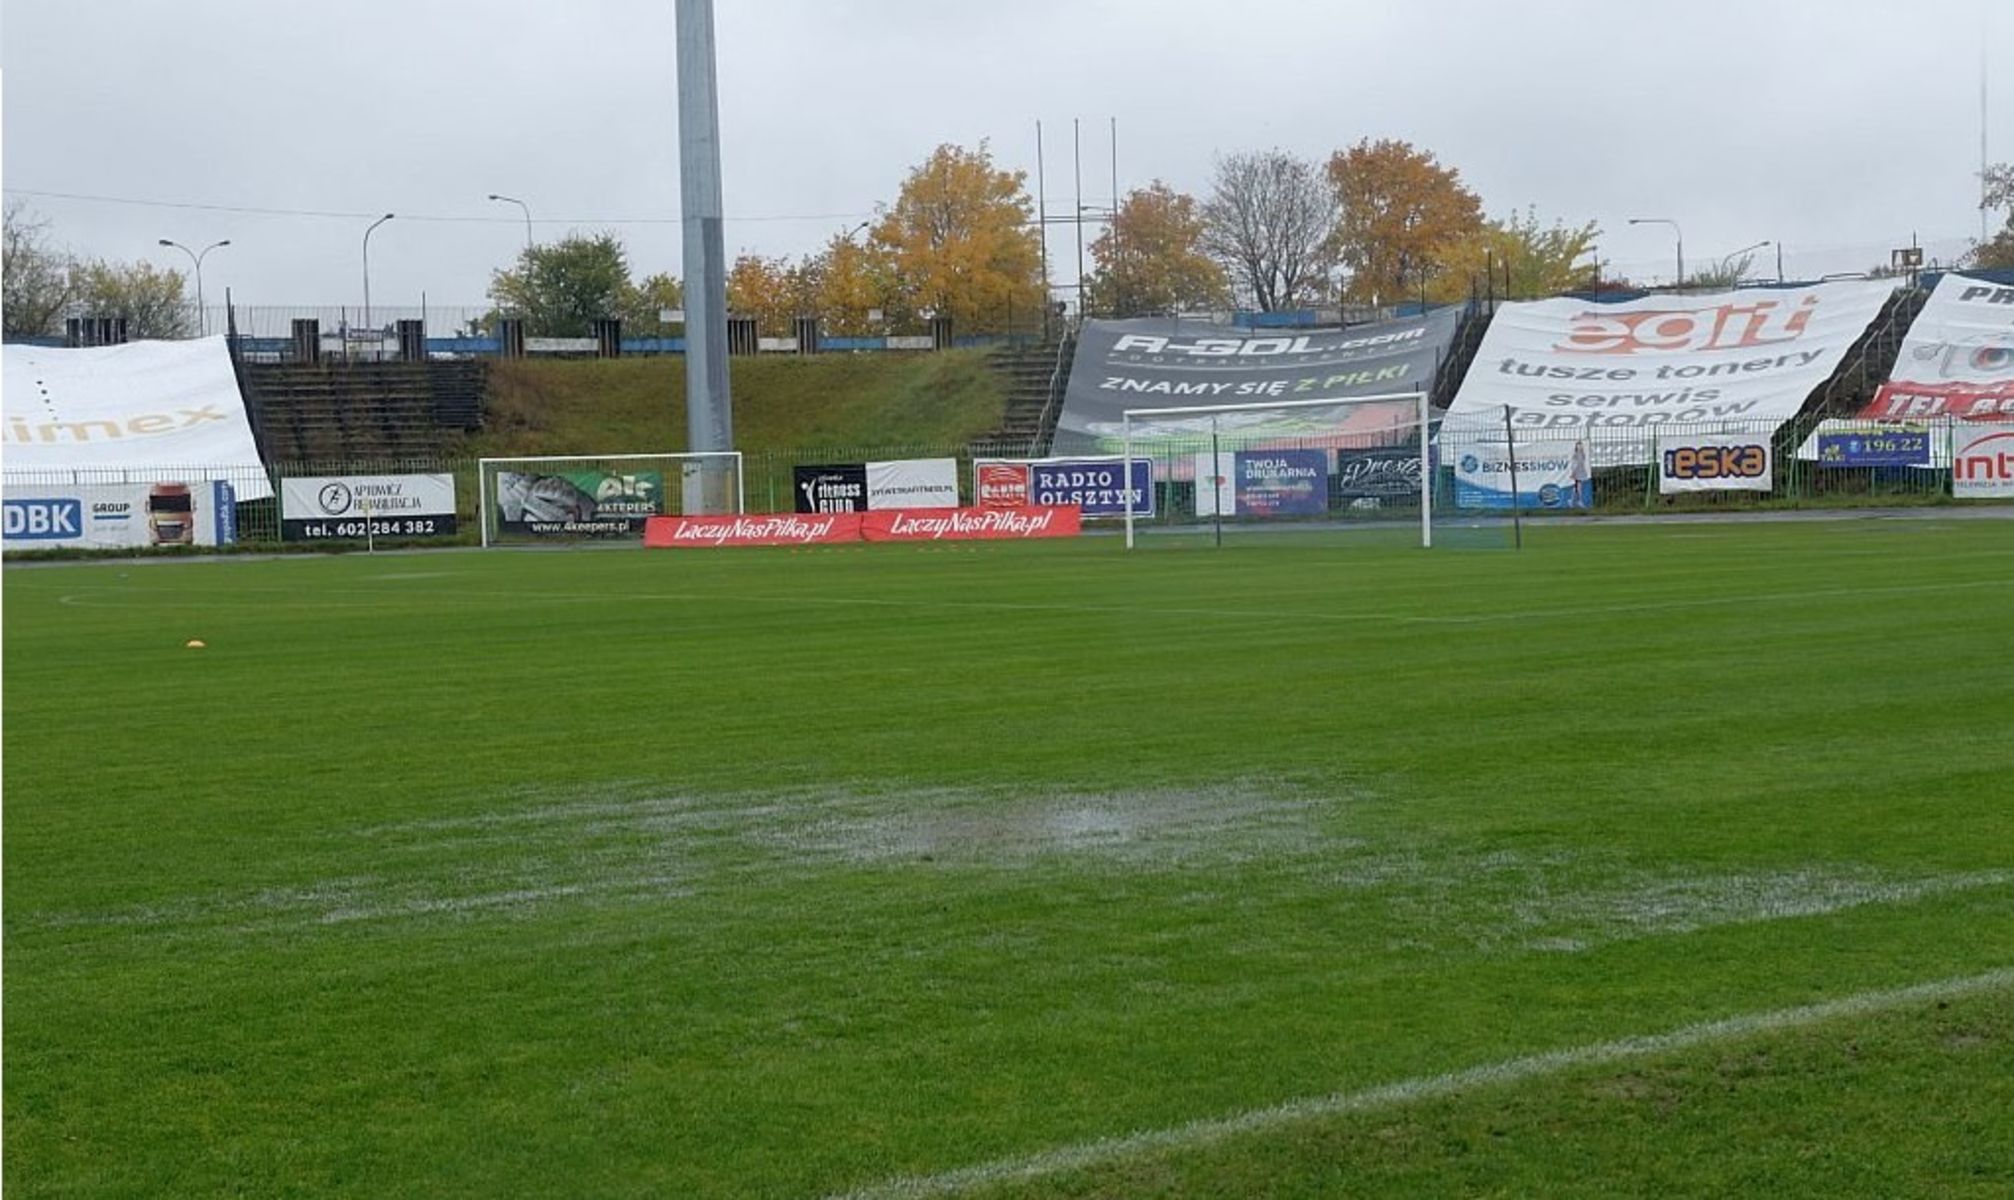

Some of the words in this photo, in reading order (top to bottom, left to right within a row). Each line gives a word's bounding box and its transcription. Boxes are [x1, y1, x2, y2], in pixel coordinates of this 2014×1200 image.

[1498, 357, 1637, 381] tusze
[1656, 348, 1824, 380] tonery
[1099, 377, 1232, 395] ZNAMY
[1235, 380, 1290, 397] SIĘ
[1293, 378, 1314, 392] Z
[1324, 364, 1411, 390] PIŁKI
[1545, 387, 1722, 408] serwis
[2, 404, 228, 443] imex
[1864, 439, 1896, 452] 196
[1901, 437, 1922, 451] 22
[1246, 459, 1287, 469] TWOJA
[1482, 461, 1568, 473] BIZNESSHOW
[1040, 472, 1111, 488] RADIO
[1246, 468, 1317, 479] DRUKARNIA
[1040, 489, 1142, 506] OLSZTYN
[93, 503, 130, 512] GROUP
[4, 505, 76, 534] DBK
[305, 525, 331, 536] tel.
[337, 523, 366, 535] 602
[371, 522, 400, 534] 284
[406, 521, 434, 533] 382
